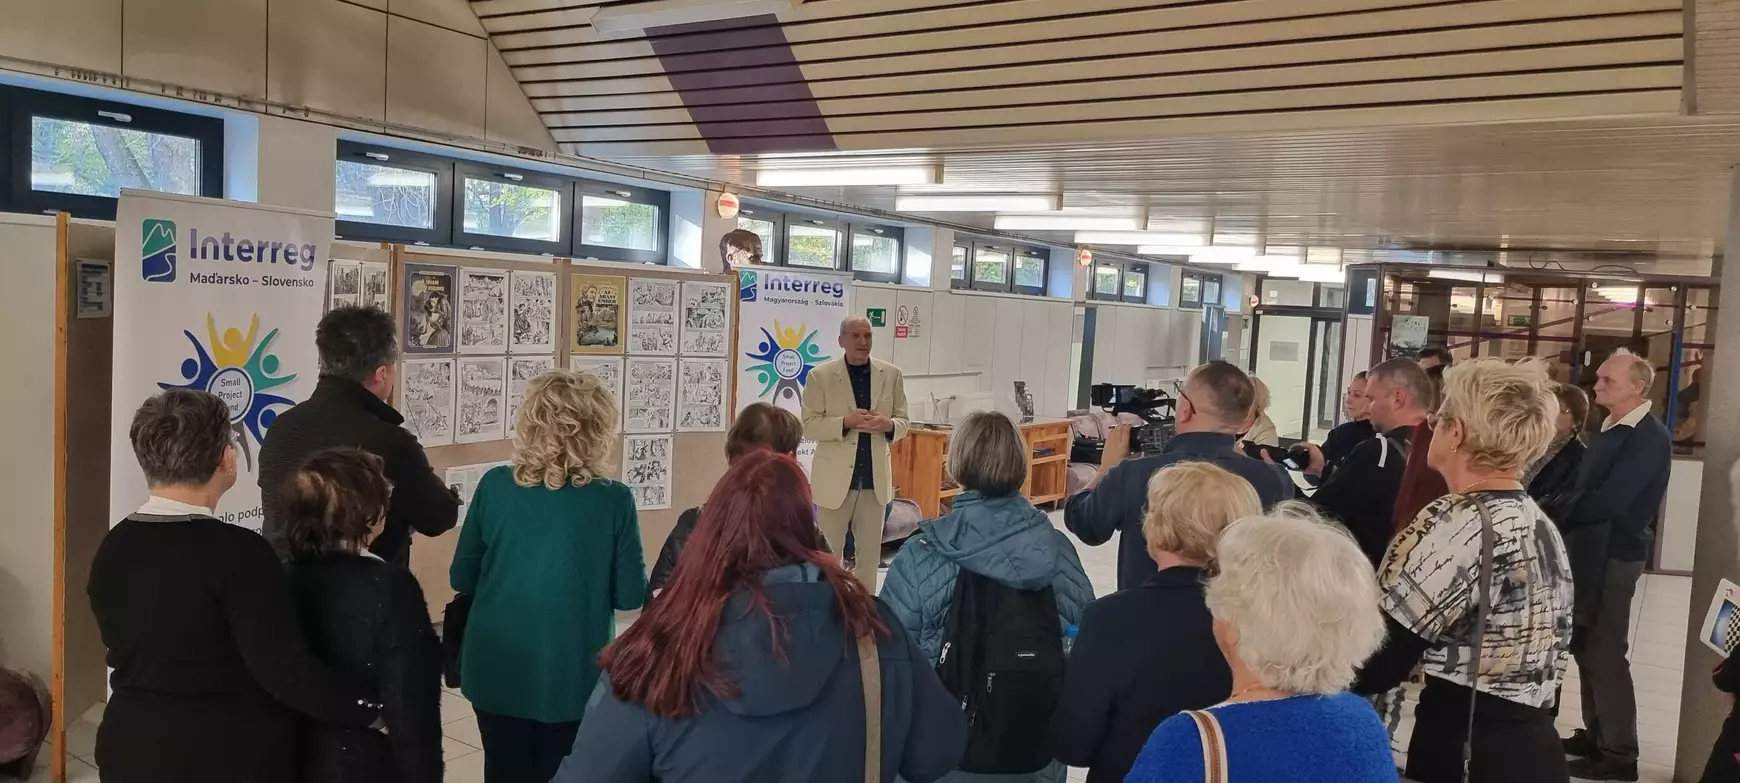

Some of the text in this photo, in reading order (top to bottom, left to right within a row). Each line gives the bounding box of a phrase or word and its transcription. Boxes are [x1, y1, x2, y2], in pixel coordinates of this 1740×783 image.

[190, 228, 316, 271] Interreg
[190, 272, 249, 285] Maďarsko
[261, 276, 314, 288] Slovensko
[764, 274, 844, 298] Interreg
[764, 296, 808, 306] Magyarország
[815, 299, 844, 307] Szlovákia
[221, 378, 240, 387] Small
[219, 391, 242, 400] Project
[230, 403, 238, 411] nd
[219, 506, 264, 523] olo podp
